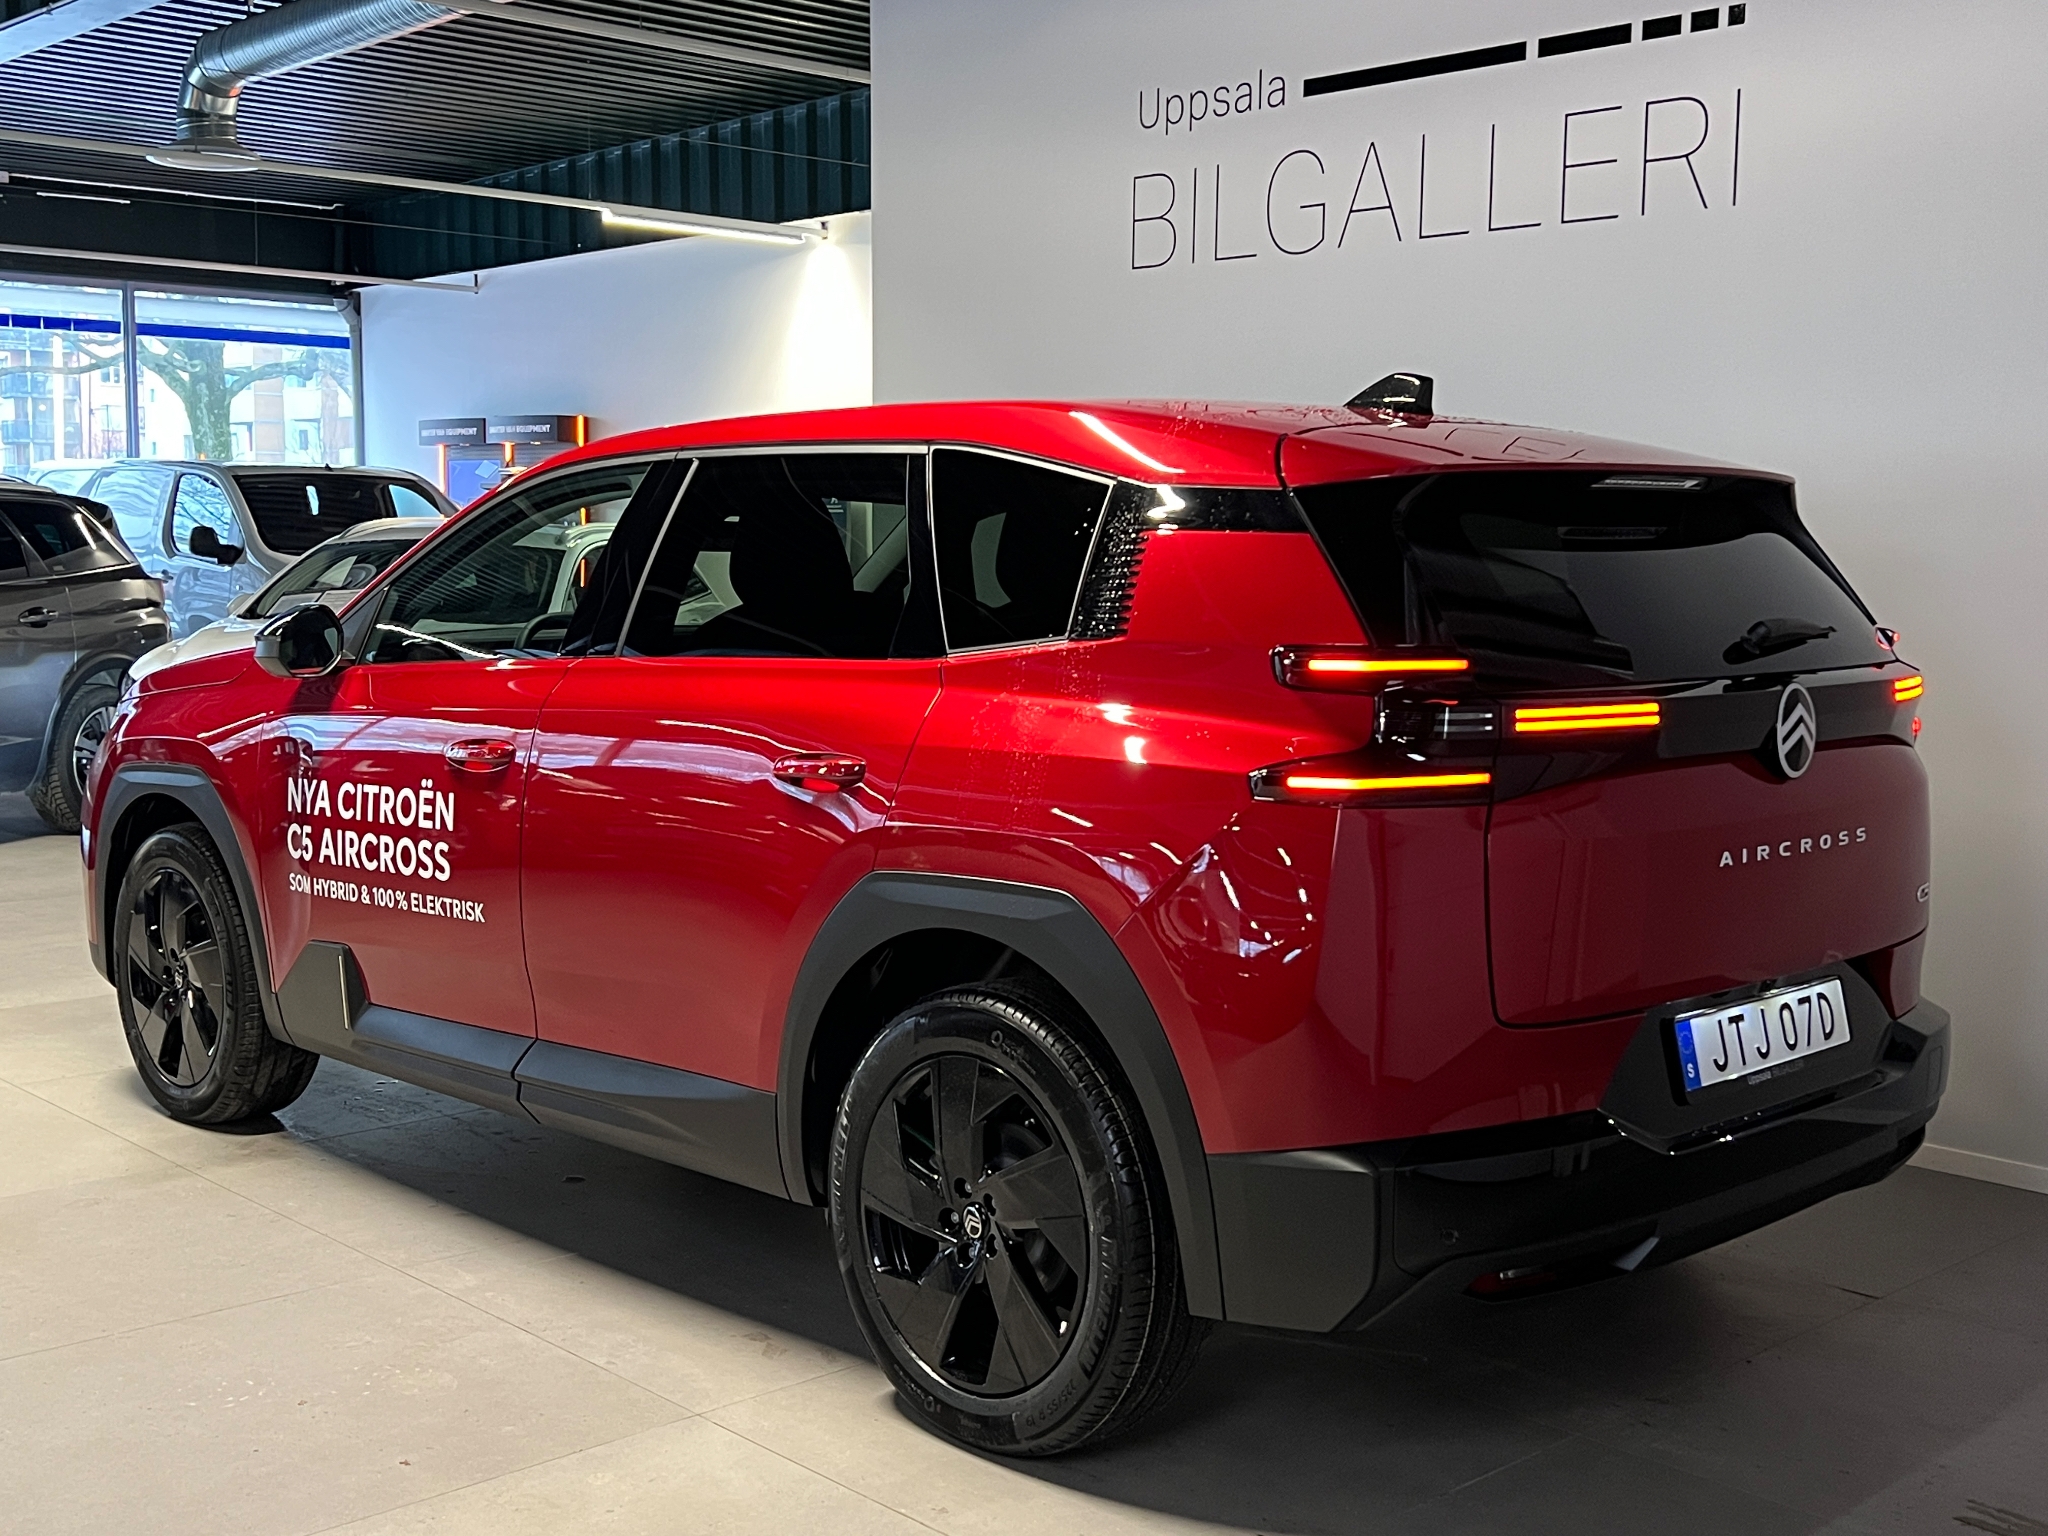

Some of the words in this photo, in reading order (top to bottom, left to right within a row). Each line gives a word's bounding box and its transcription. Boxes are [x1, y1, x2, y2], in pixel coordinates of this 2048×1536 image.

[1138, 69, 1287, 136] Uppsala
[1131, 87, 1742, 270] BILGALLERI
[287, 777, 331, 818] NYA
[337, 778, 455, 832] CITROËN
[286, 823, 313, 862] C5
[318, 827, 451, 882] AIRCROSS
[1719, 827, 1867, 867] AIRCROSS
[289, 873, 311, 894] SOM
[313, 878, 359, 903] HYBRID
[360, 885, 371, 905] &
[411, 892, 486, 923] ELEKTRISK
[1712, 1007, 1771, 1073] JTJ
[1687, 1062, 1695, 1079] S
